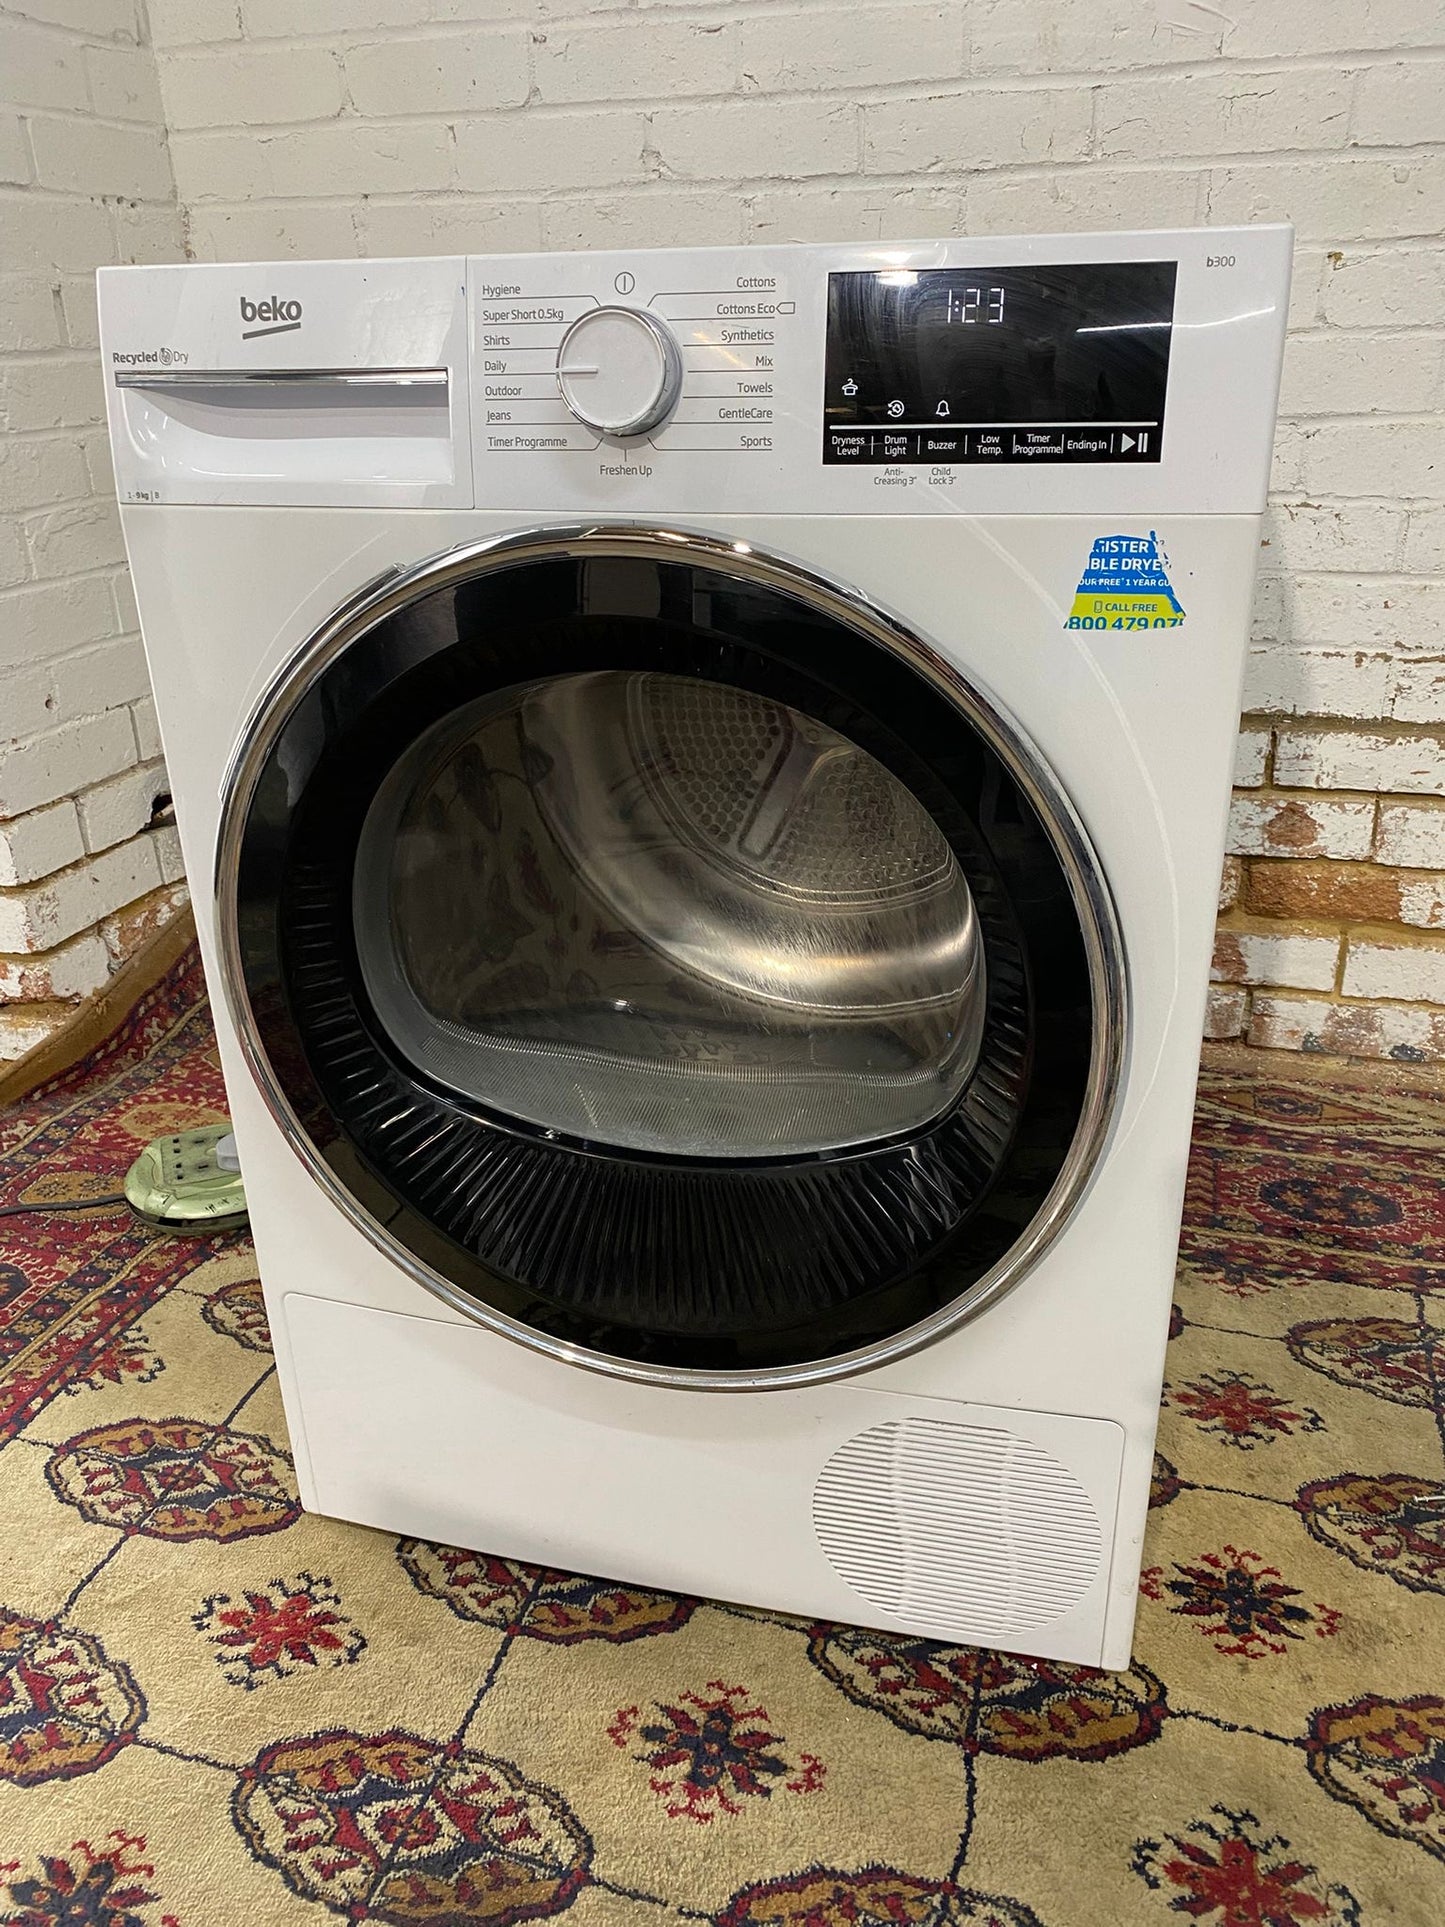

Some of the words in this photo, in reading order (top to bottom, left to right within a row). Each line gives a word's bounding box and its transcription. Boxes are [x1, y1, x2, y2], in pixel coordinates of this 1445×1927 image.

[1206, 256, 1236, 268] b300
[736, 277, 776, 288] Cottons
[482, 284, 521, 297] Hygiene
[240, 295, 303, 323] beko
[716, 303, 756, 315] Cottons
[757, 303, 776, 314] Eco
[947, 287, 1005, 324] 1:23
[482, 310, 509, 322] Super
[511, 309, 537, 320] Short
[537, 308, 564, 320] 0.5kg
[483, 335, 511, 346] Shirts
[721, 329, 774, 343] Synthetics
[112, 351, 158, 365] Recycled
[173, 351, 189, 364] Dry
[755, 356, 774, 367] Mix
[484, 360, 507, 373] Daily
[484, 385, 522, 396] Outdoor
[737, 382, 773, 393] Towels
[486, 410, 512, 422] Jeans
[718, 408, 773, 419] GentleCare
[487, 436, 514, 447] Timer
[515, 436, 568, 449] Programme
[740, 435, 773, 448] Sports
[831, 435, 865, 447] Dryness
[884, 435, 908, 445] Drum
[981, 434, 1000, 444] Low
[1026, 433, 1051, 443] Timer
[927, 440, 957, 450] Buzzer
[976, 445, 1003, 455] Temp.
[1015, 445, 1061, 456] Programme
[1067, 440, 1098, 451] Ending
[1098, 440, 1107, 449] In
[836, 446, 860, 456] Level
[884, 446, 907, 457] Light
[599, 464, 638, 476] Freshen
[639, 465, 653, 478] Up
[884, 467, 904, 476] Anti-
[931, 467, 951, 476] Child
[873, 476, 908, 487] Creasing
[928, 476, 947, 485] Lock
[1089, 558, 1119, 570] BLE
[1133, 578, 1157, 586] YEAR
[1105, 602, 1130, 612] CALL
[1132, 603, 1158, 612] FREE
[1111, 617, 1149, 631] 479
